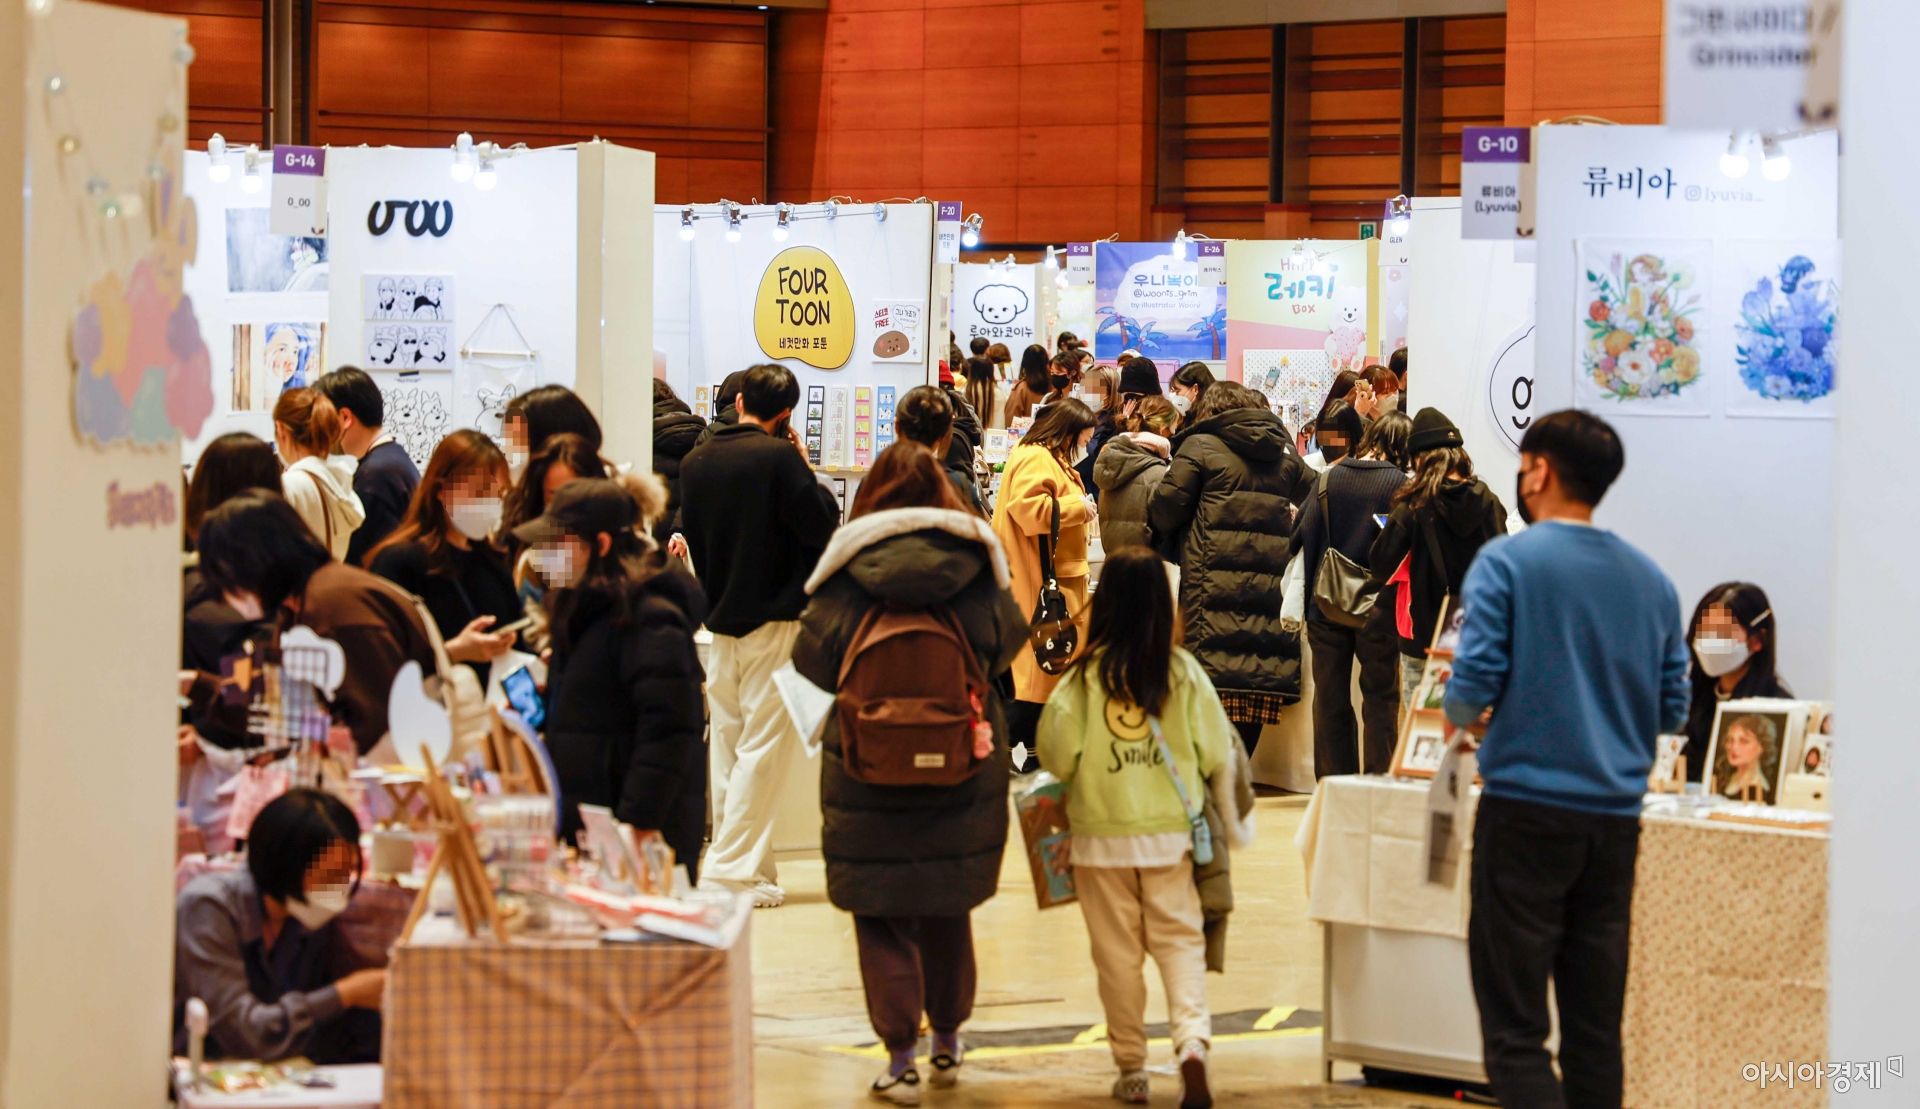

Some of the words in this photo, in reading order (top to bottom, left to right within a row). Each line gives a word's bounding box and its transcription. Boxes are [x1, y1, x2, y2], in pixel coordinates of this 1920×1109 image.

[1478, 136, 1518, 153] G-10
[285, 153, 316, 167] G-14
[1583, 166, 1677, 199] 류비아
[1481, 185, 1516, 197] 류비아
[941, 206, 956, 216] F-20
[1475, 200, 1522, 214] (Lyuvia)
[1073, 245, 1089, 253] E-28
[778, 266, 829, 295] FOUR
[1264, 272, 1335, 300] 레키
[1133, 288, 1198, 300] @woonis_grim
[776, 299, 830, 326] TOON
[874, 318, 889, 328] FREE
[970, 325, 1033, 341] 루아와코이누
[779, 337, 810, 350] 네컷만화
[813, 337, 827, 350] 포툰
[1107, 734, 1165, 774] Smile
